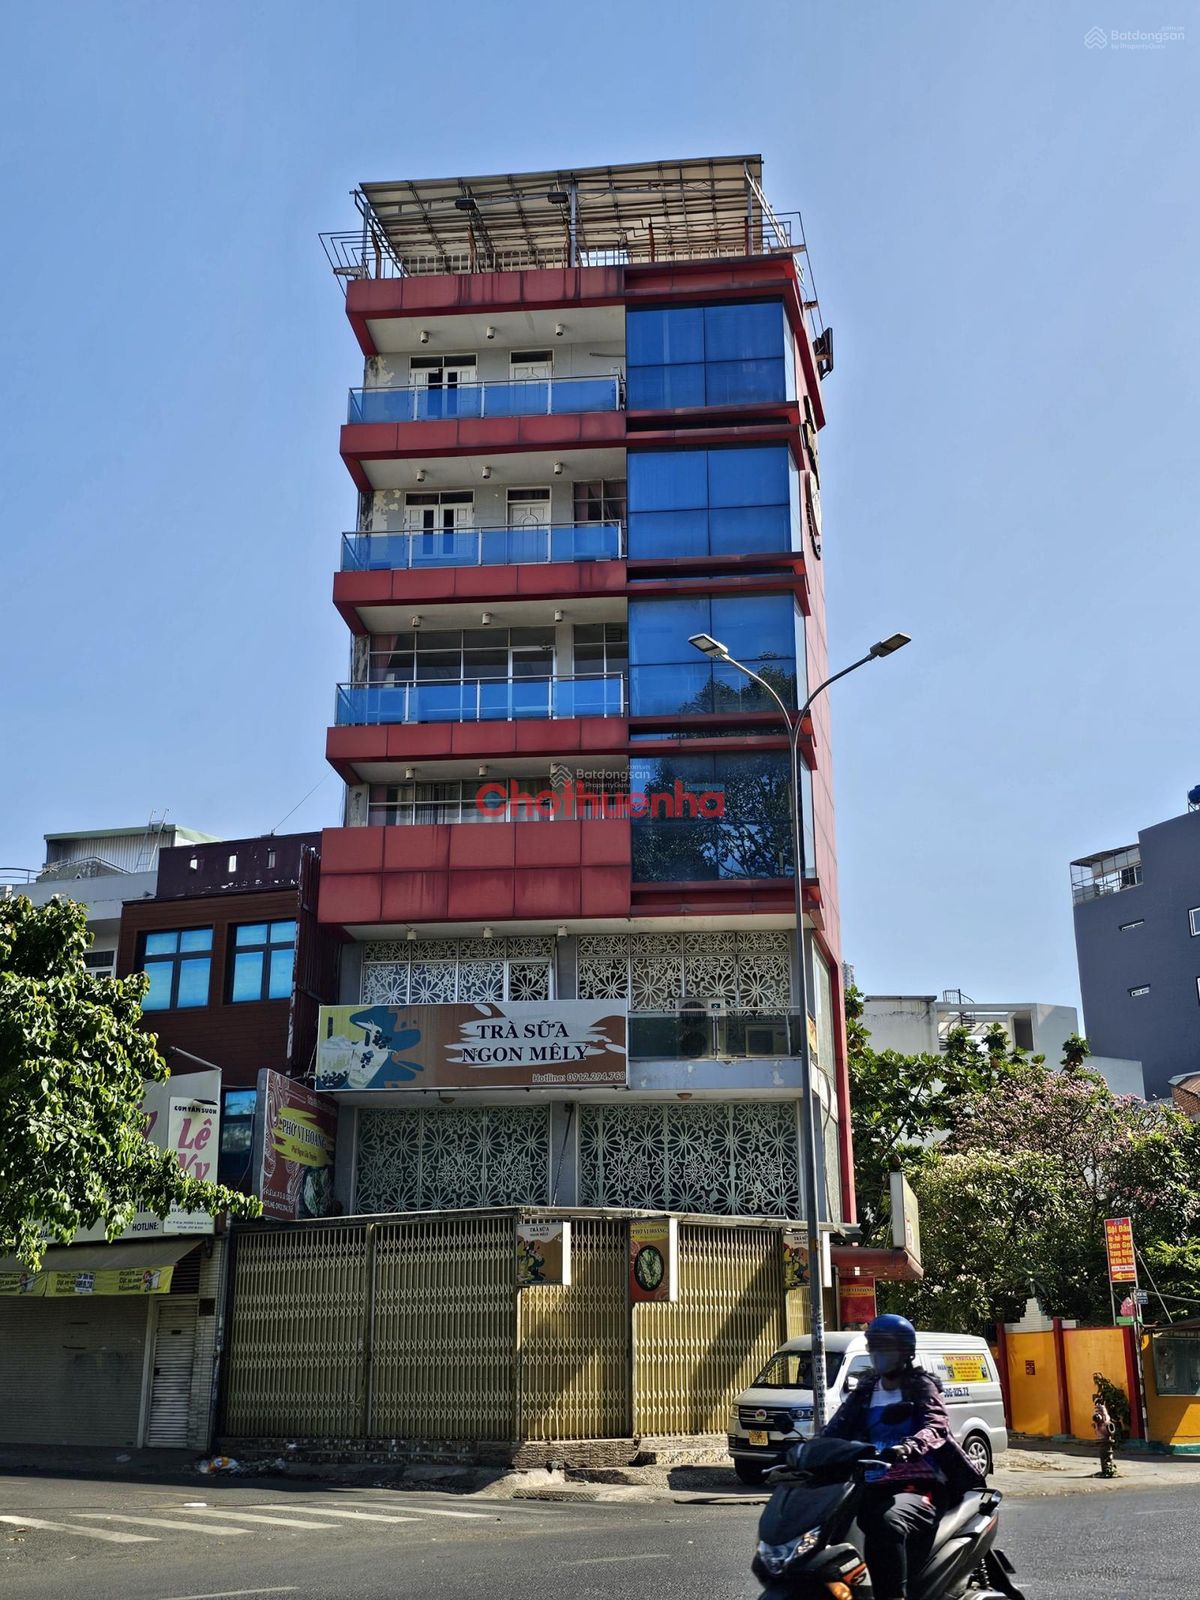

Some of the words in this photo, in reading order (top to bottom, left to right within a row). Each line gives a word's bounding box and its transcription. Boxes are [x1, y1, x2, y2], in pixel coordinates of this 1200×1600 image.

[477, 1020, 519, 1039] TRÀ
[462, 1046, 524, 1062] NGON
[529, 1042, 589, 1061] MÊLY
[532, 1073, 566, 1083] Hotline:
[178, 1118, 212, 1150] Lê
[132, 1222, 159, 1231] HOTLINE:
